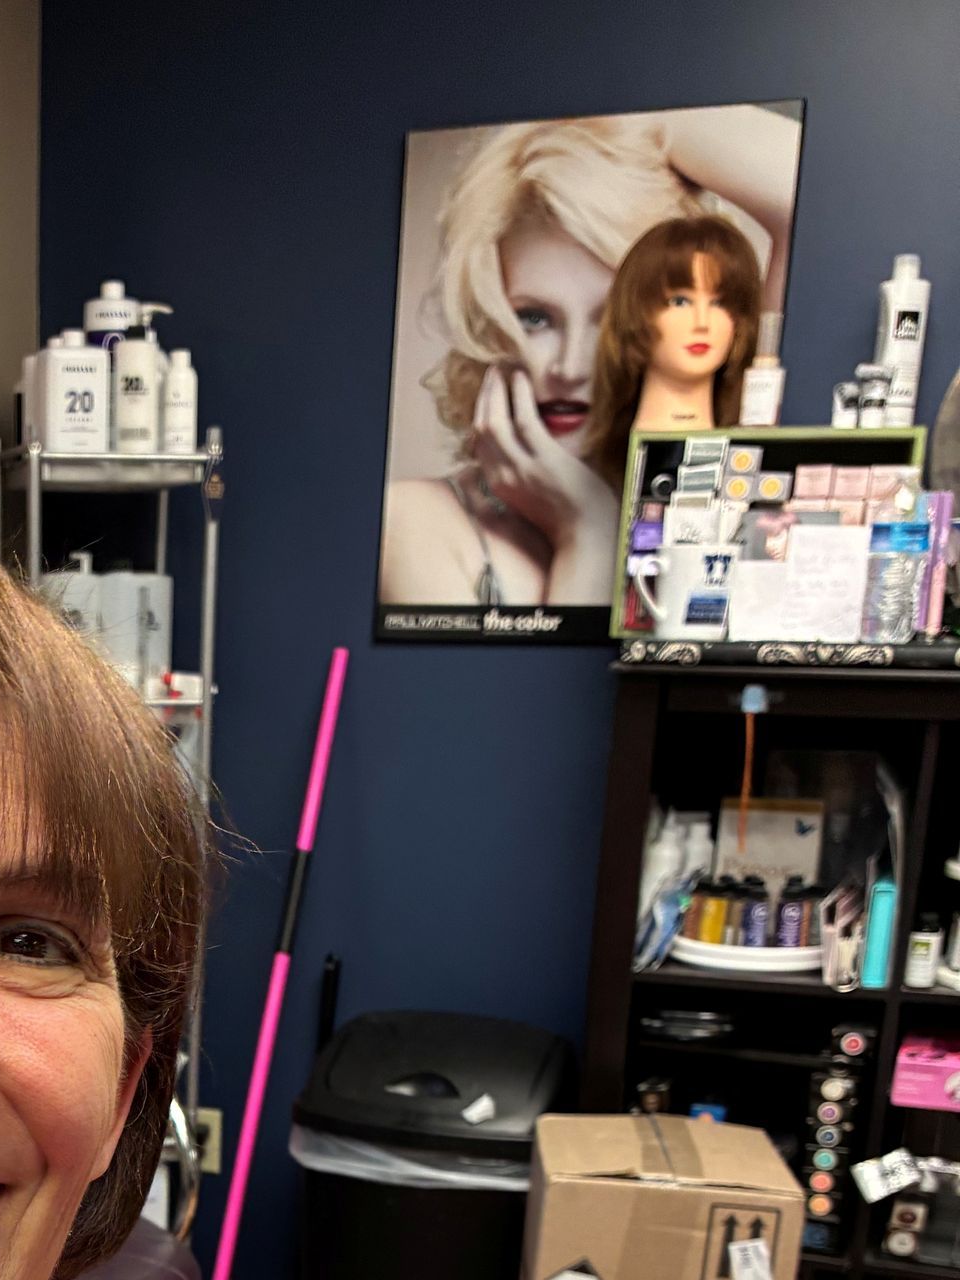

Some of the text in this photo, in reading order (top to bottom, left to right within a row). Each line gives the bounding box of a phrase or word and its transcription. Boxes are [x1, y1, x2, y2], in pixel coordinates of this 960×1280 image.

[64, 390, 95, 414] 20
[483, 607, 513, 631] the
[514, 607, 562, 632] color
